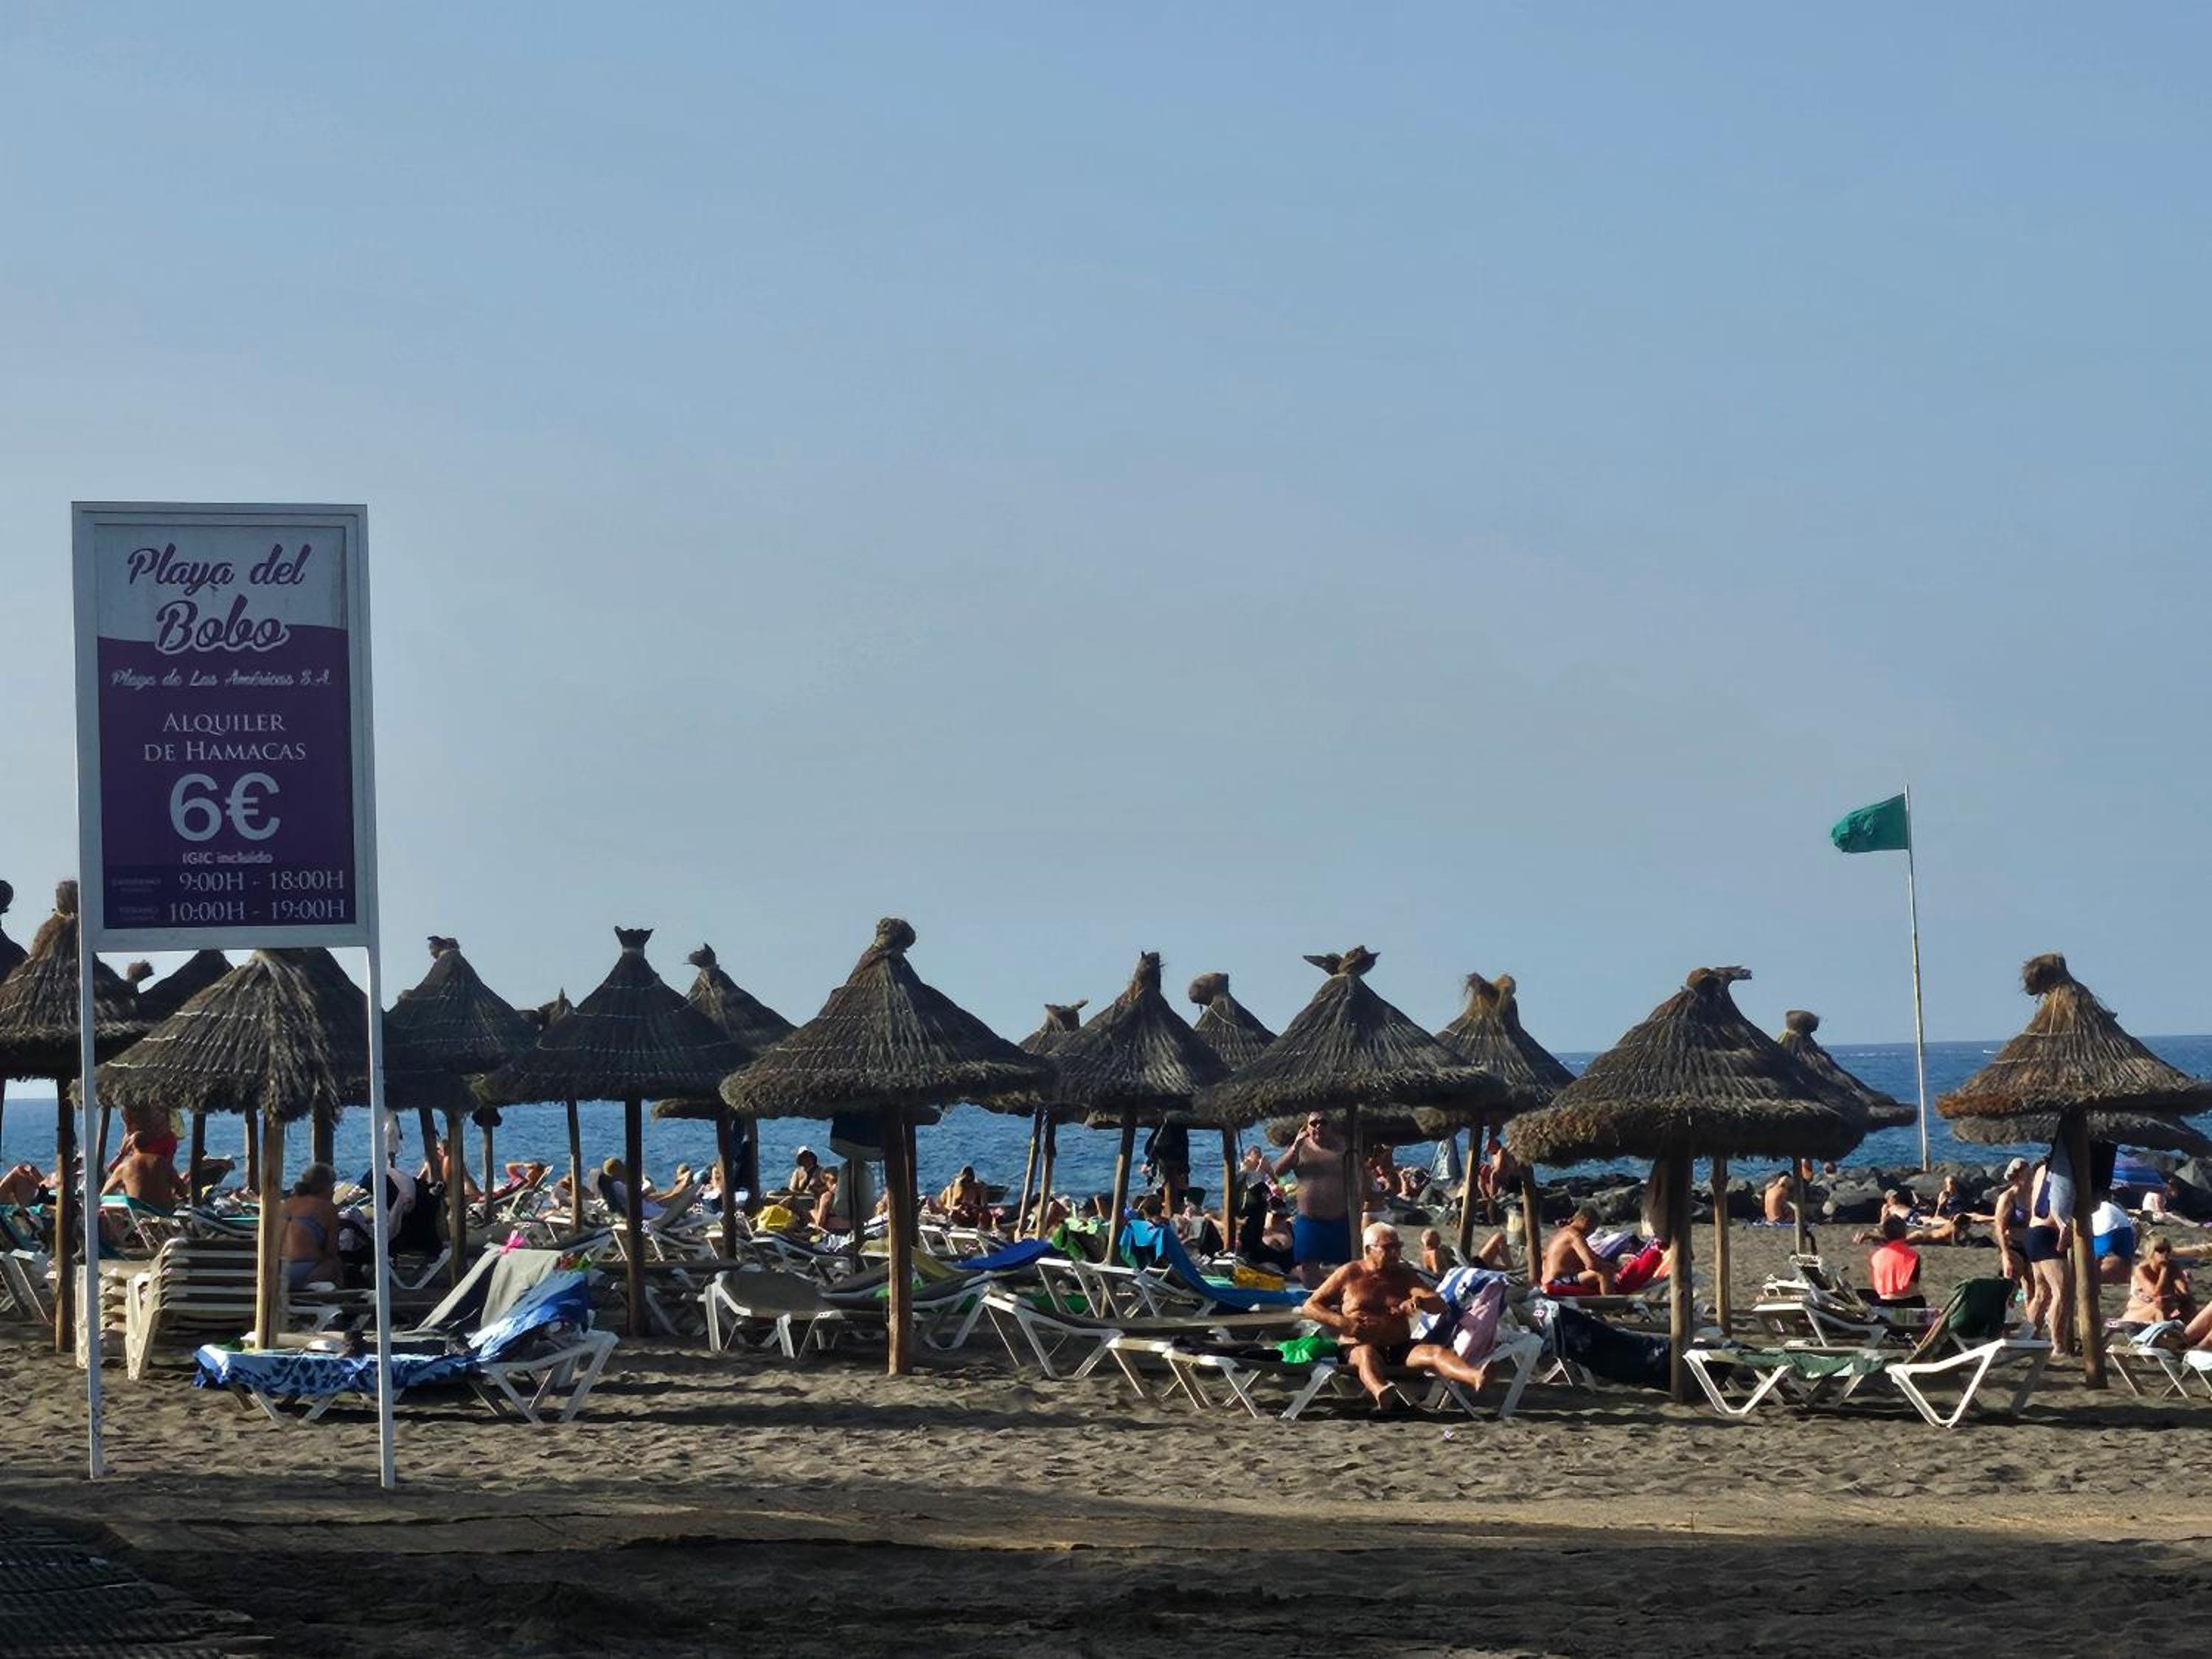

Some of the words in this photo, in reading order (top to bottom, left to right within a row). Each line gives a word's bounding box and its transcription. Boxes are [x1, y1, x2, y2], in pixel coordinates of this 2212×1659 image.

[128, 543, 235, 596] Playa
[249, 543, 312, 585] del
[156, 594, 289, 653] Bobo
[189, 669, 218, 686] Las
[144, 743, 175, 762] DE
[170, 772, 281, 842] 6€
[182, 852, 213, 864] IGIC
[179, 872, 244, 891] 9:00H
[270, 870, 344, 890] 18:00H
[170, 902, 245, 921] 10:00H
[271, 899, 345, 919] 19:00H
